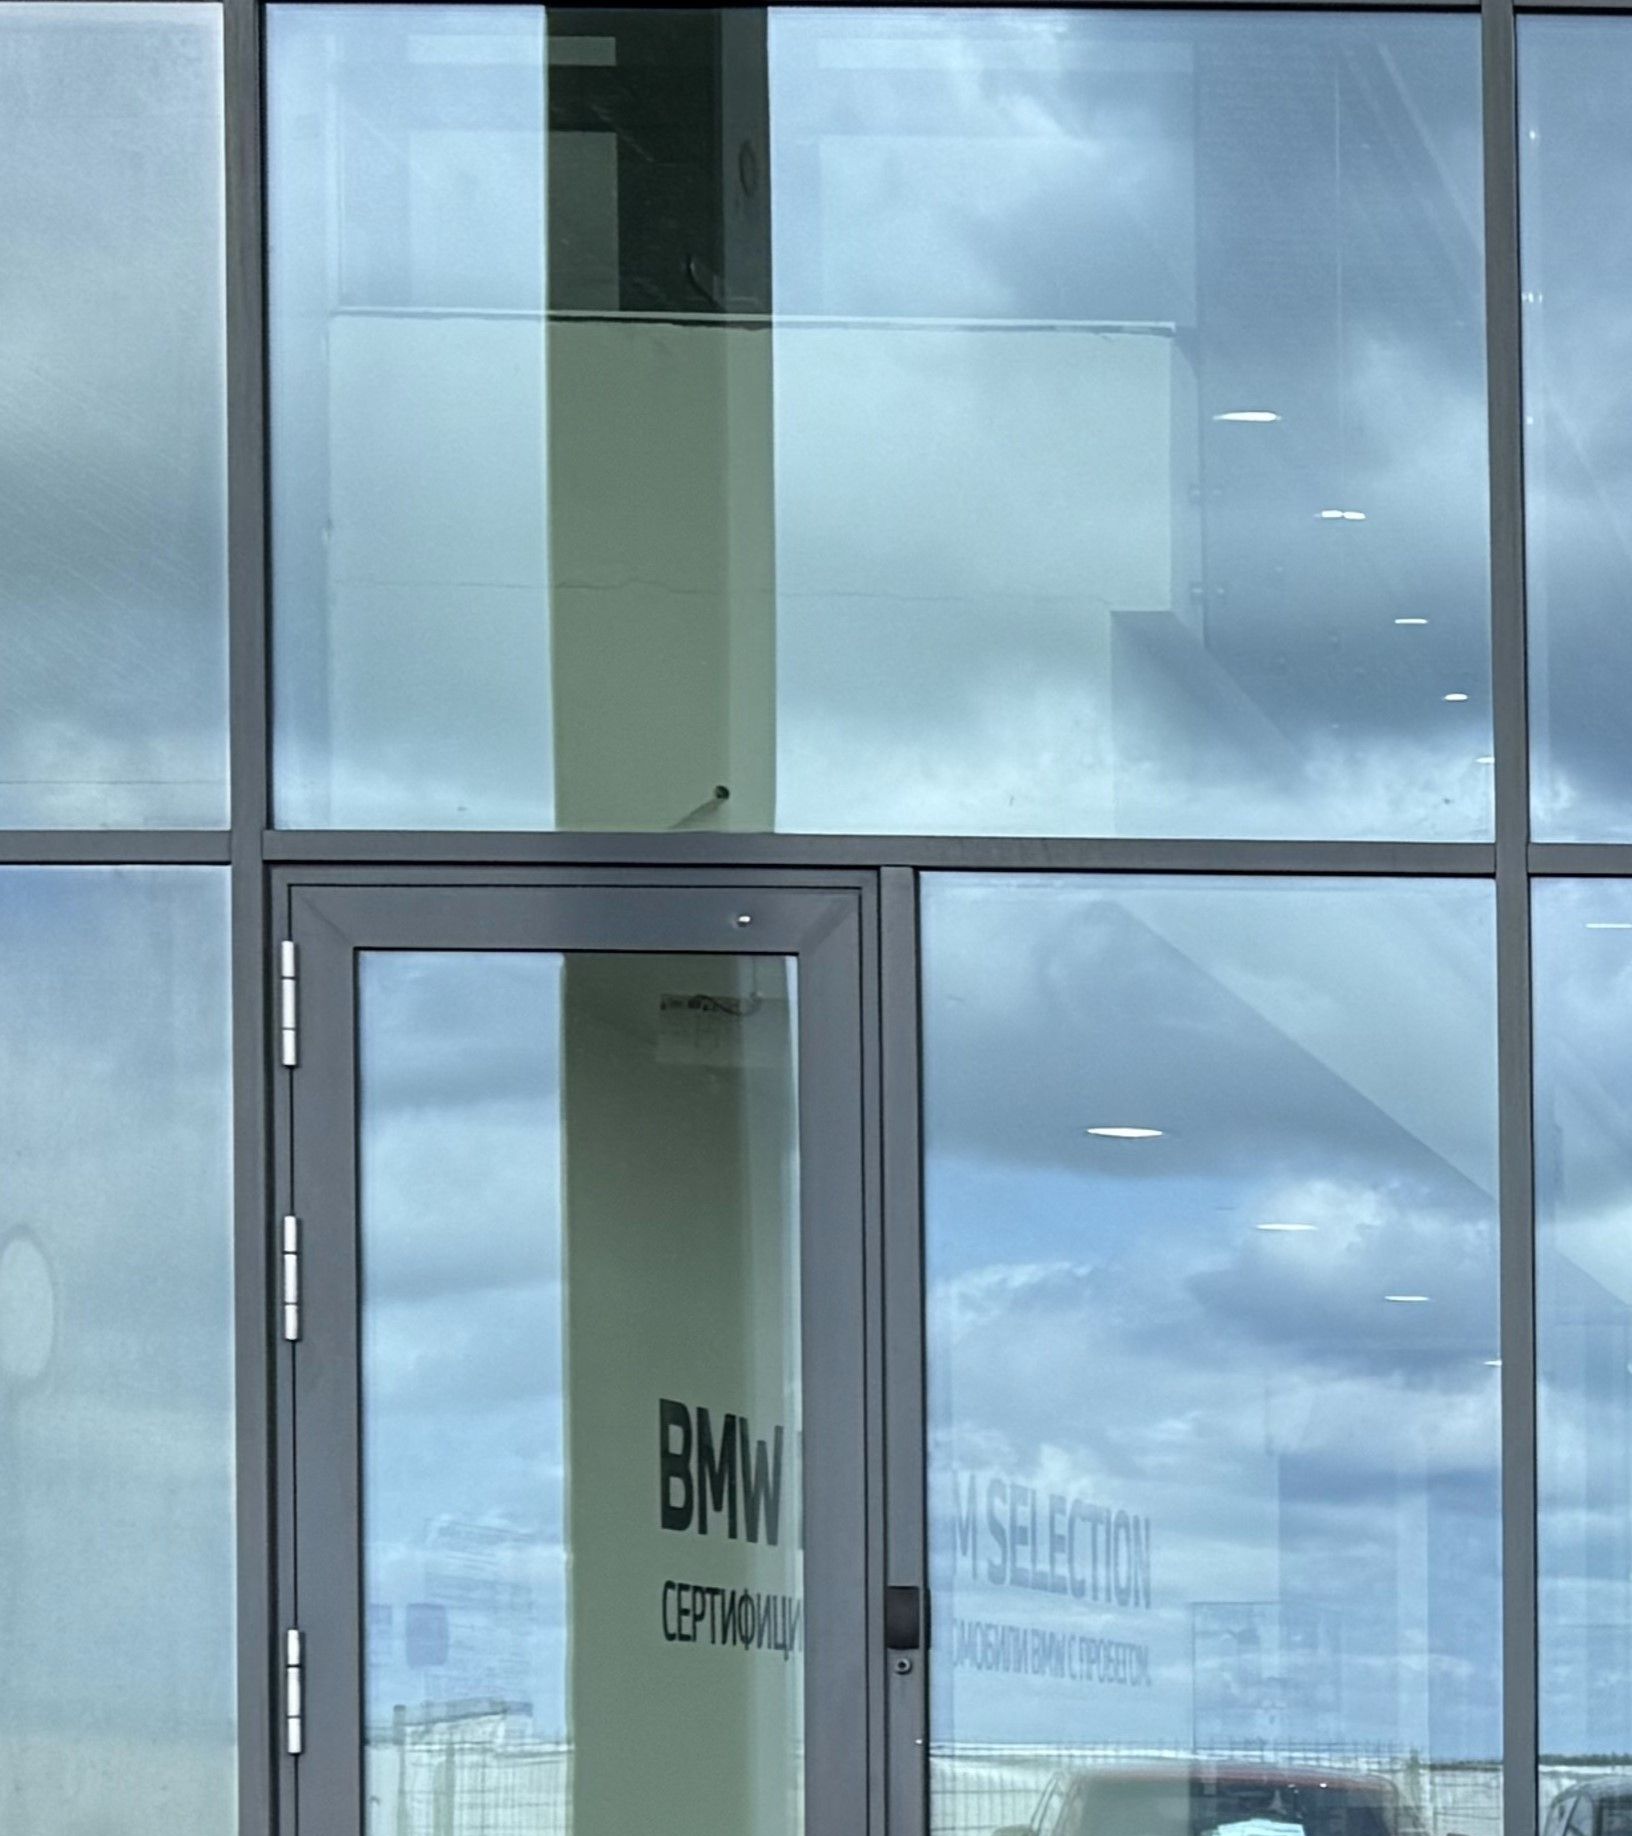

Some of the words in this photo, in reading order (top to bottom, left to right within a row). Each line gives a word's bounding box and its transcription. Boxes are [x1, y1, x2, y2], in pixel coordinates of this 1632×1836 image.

[659, 1398, 784, 1546] BMW
[986, 1476, 1151, 1610] SELECTION
[662, 1580, 802, 1661] СЕРТИФИЦИ
